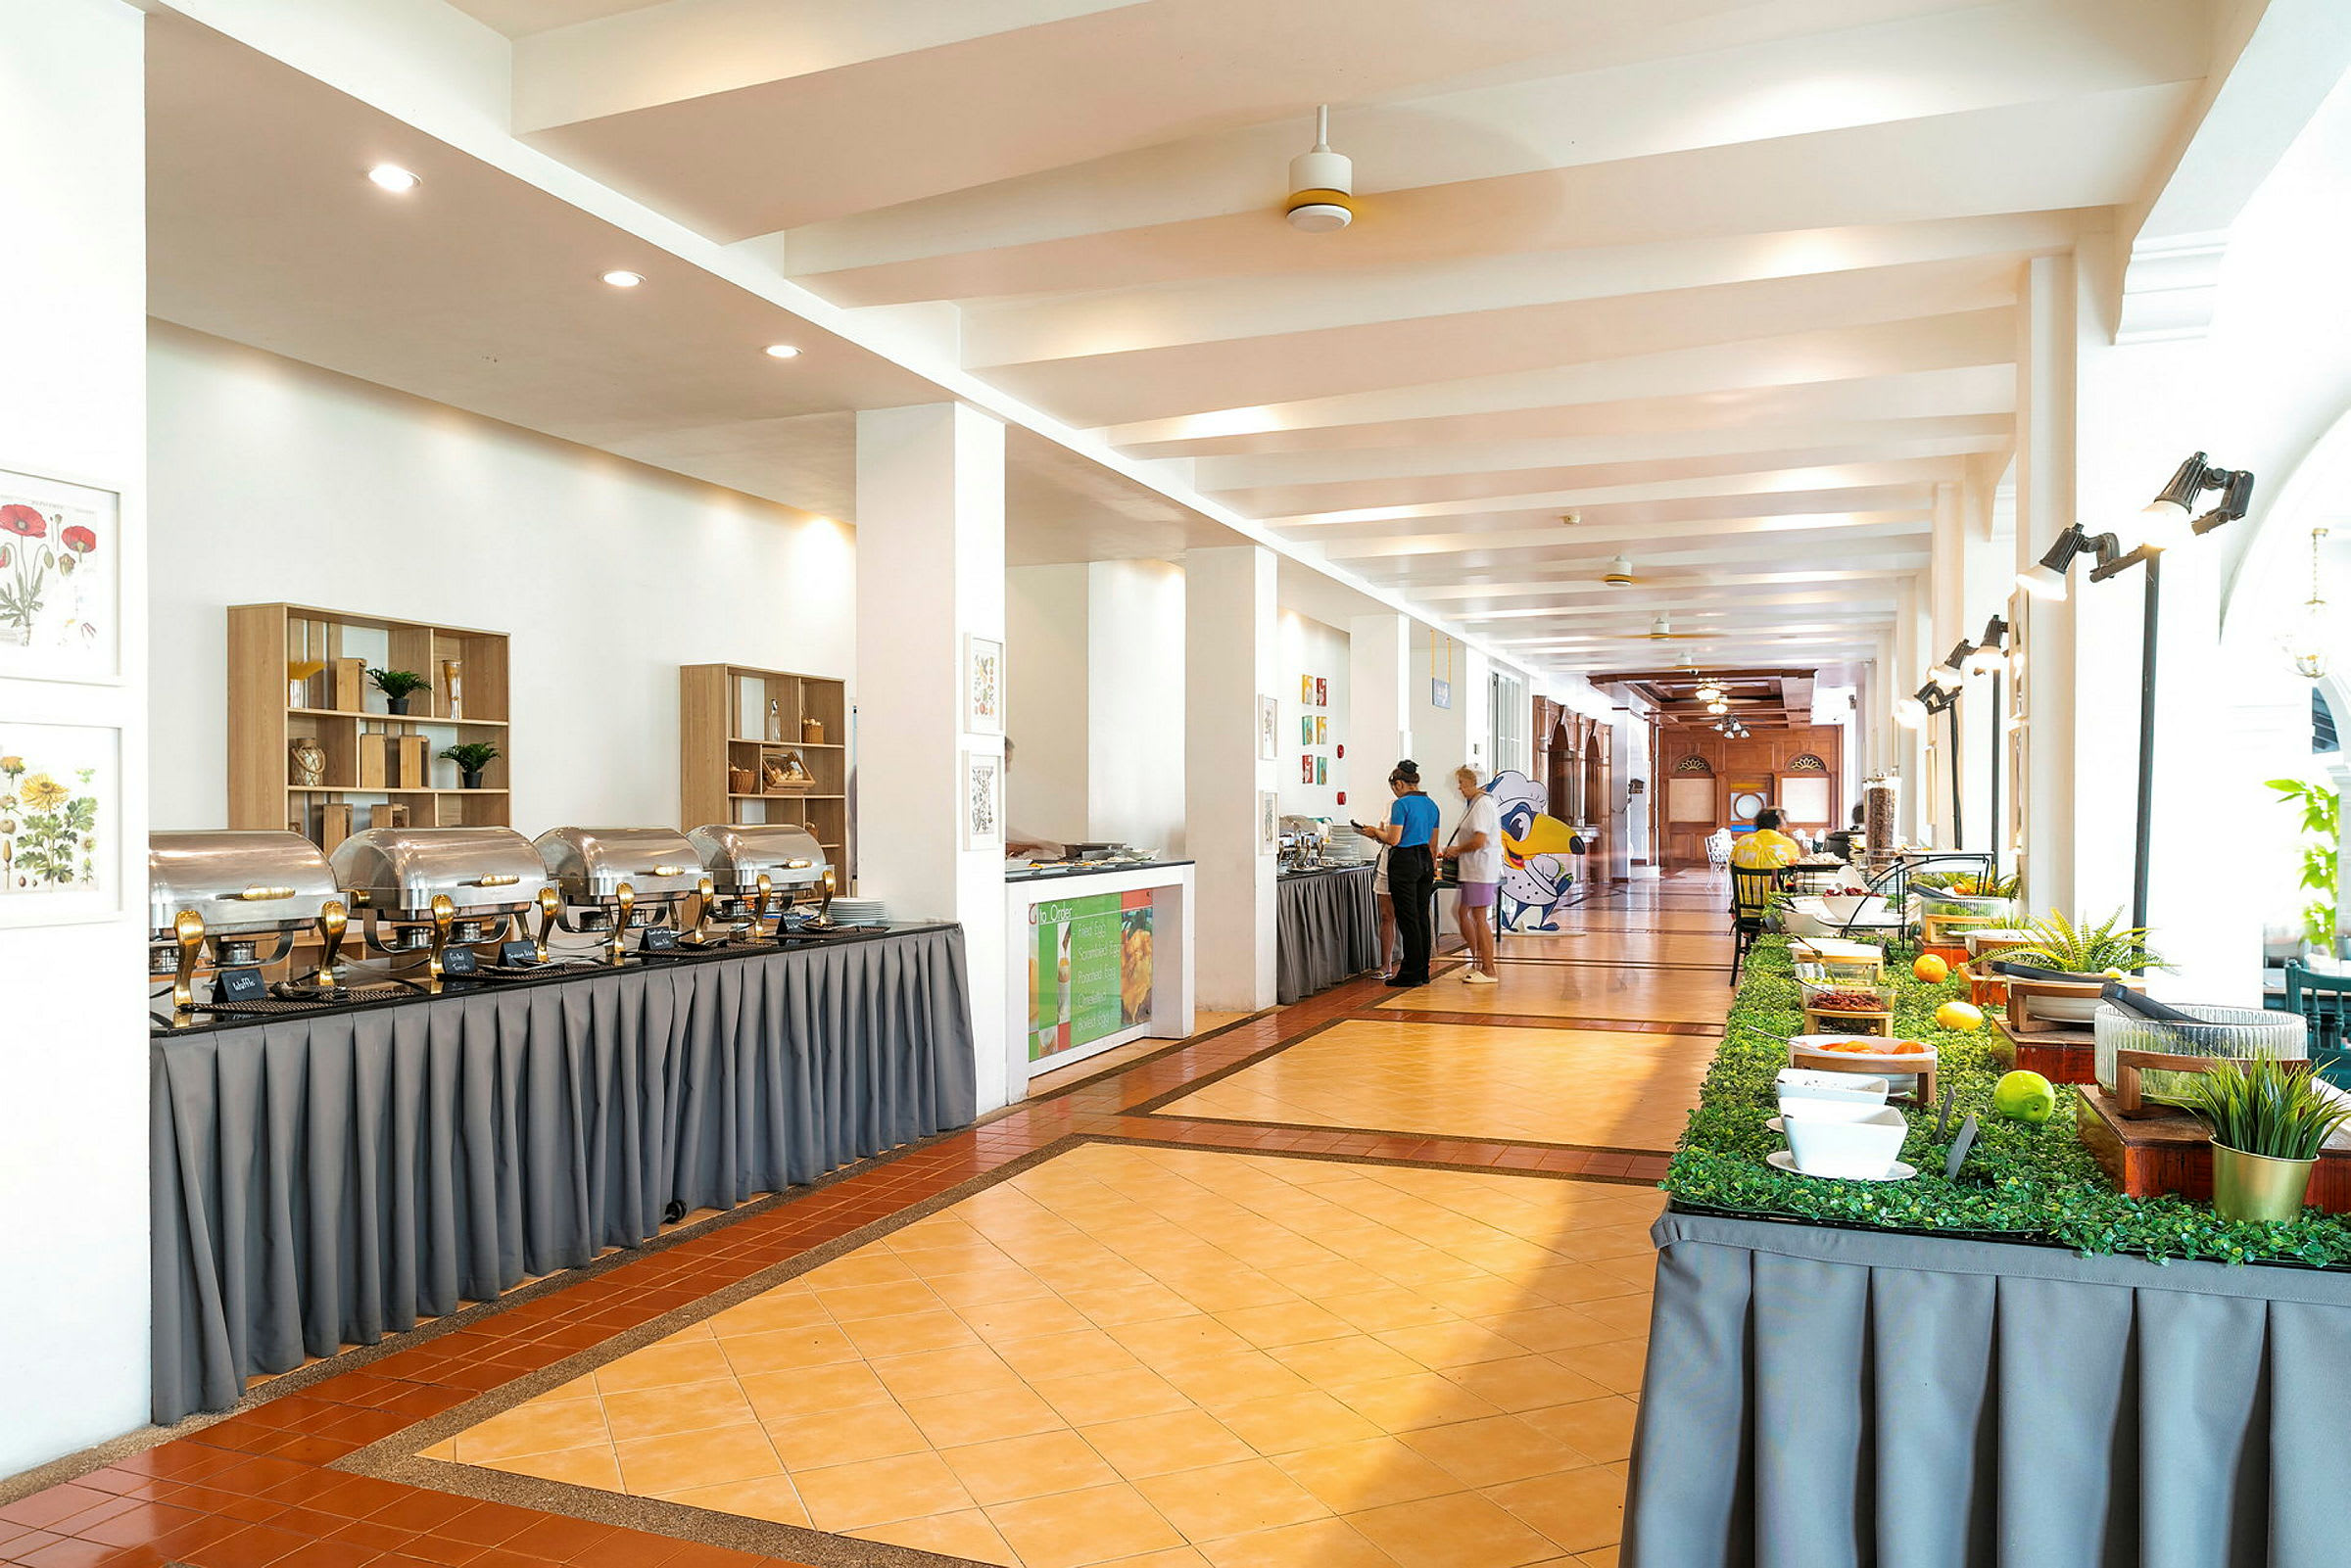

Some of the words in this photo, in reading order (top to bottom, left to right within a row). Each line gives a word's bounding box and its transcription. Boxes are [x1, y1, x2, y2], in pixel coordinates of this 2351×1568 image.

[1039, 908, 1047, 924] to
[1050, 901, 1073, 921] Order
[1094, 921, 1106, 938] Egg
